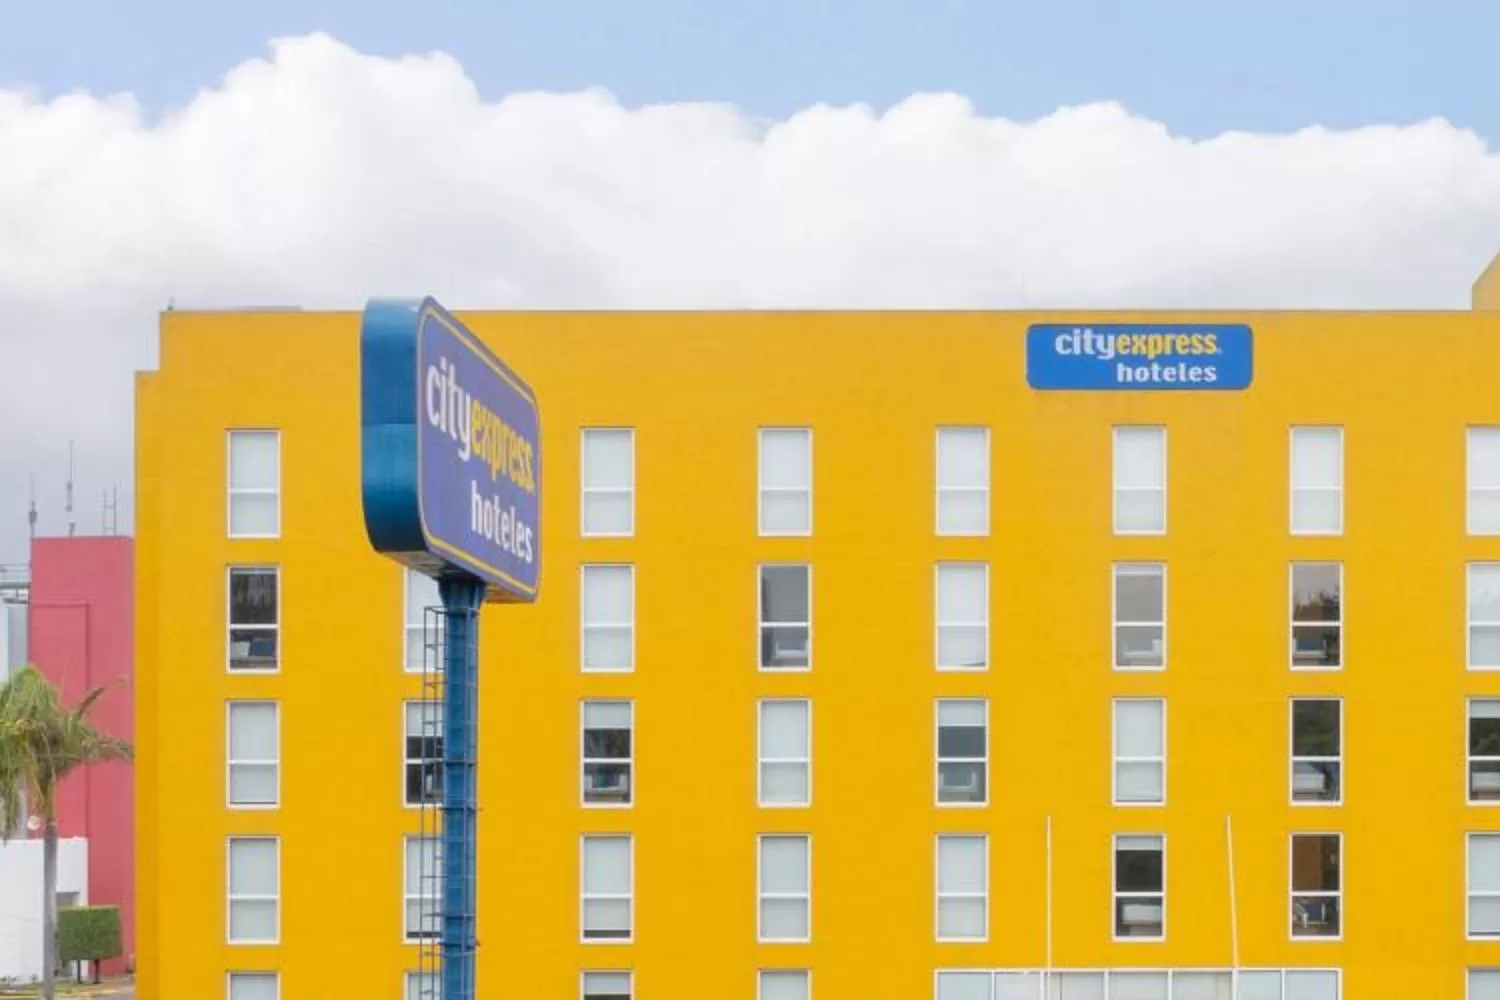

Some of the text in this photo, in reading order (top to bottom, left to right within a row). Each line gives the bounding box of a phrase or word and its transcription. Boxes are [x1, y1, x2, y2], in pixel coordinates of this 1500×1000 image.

[1054, 328, 1217, 360] cityexpress
[1116, 362, 1217, 383] hoteles
[427, 356, 534, 492] cityexpress
[471, 479, 533, 563] hoteles
